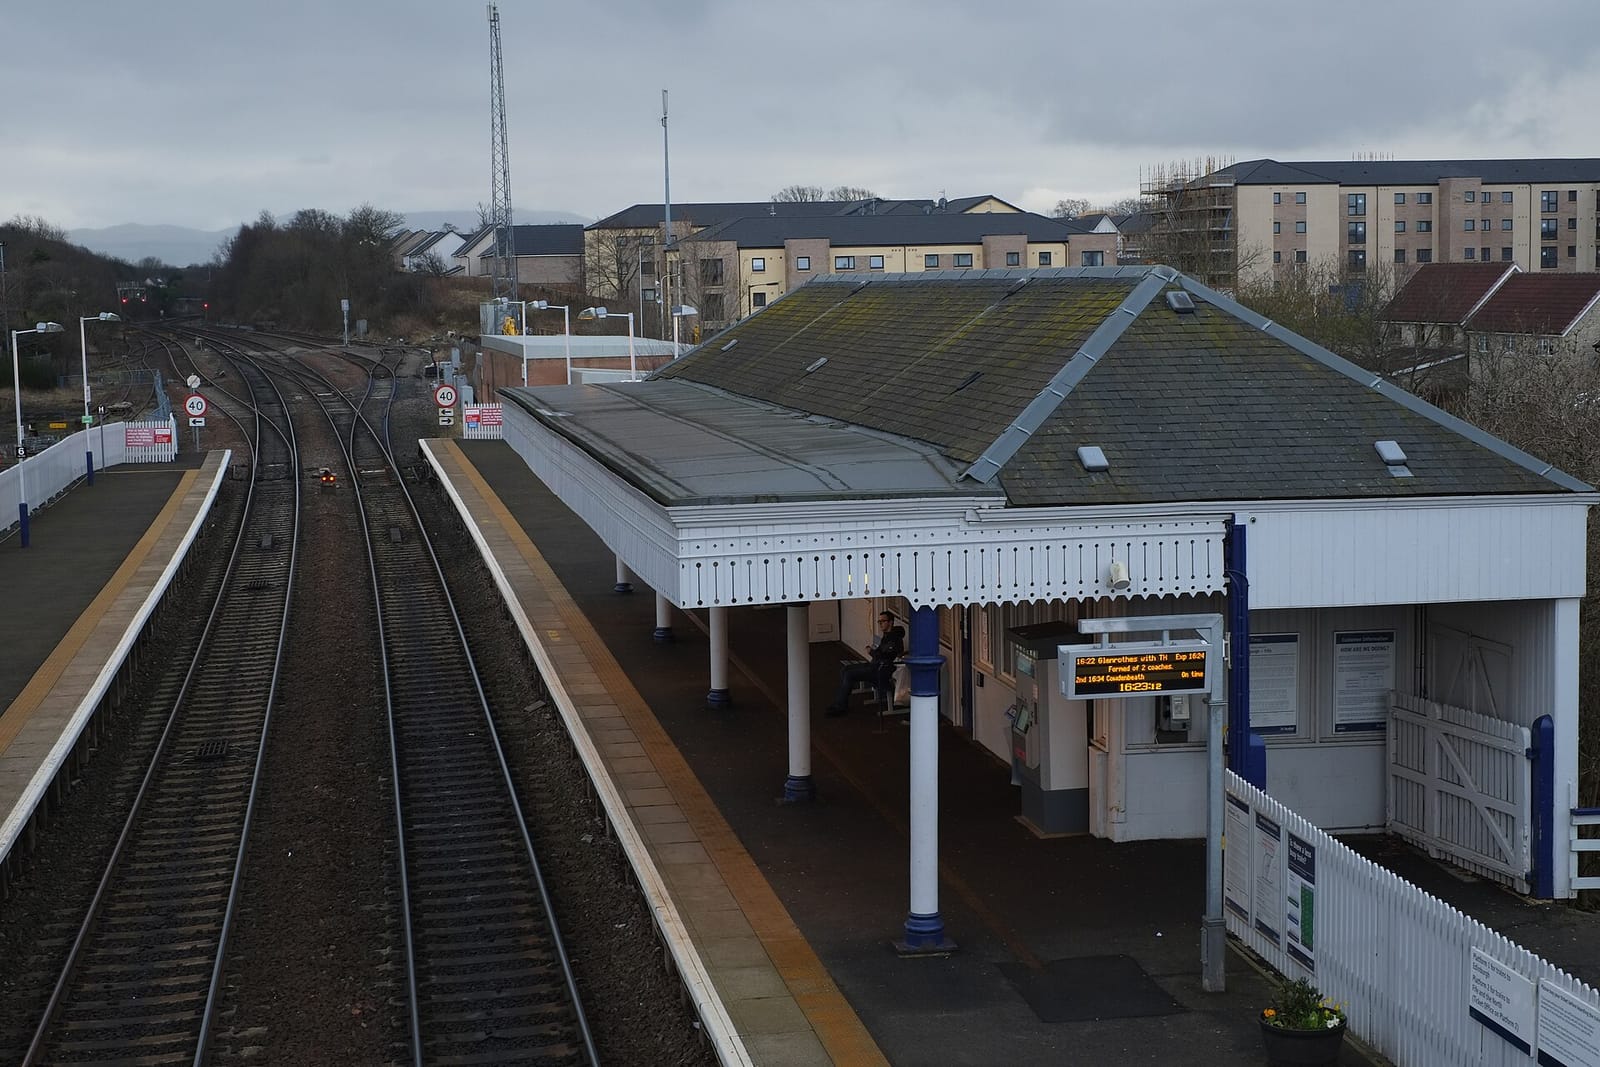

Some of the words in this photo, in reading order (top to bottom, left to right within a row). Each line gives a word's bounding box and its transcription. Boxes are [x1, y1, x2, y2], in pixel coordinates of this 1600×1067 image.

[440, 391, 453, 401] 40
[188, 401, 203, 410] 40
[18, 447, 25, 456] 6
[1098, 656, 1138, 664] Glenrothes
[1140, 654, 1156, 662] with
[1175, 653, 1187, 661] Exp
[1108, 664, 1130, 672] Formed
[1106, 673, 1144, 682] Cowdenbeath
[1119, 682, 1162, 692] 16:23:12
[1472, 953, 1487, 968] Platform
[1495, 967, 1505, 979] trains
[1506, 974, 1511, 982] to
[1472, 962, 1490, 979] Edinburgh
[1472, 974, 1487, 989] Platform
[1495, 990, 1505, 1002] trains
[1492, 998, 1503, 1009] North
[1483, 1002, 1494, 1015] Office
[1499, 1011, 1514, 1028] Platform
